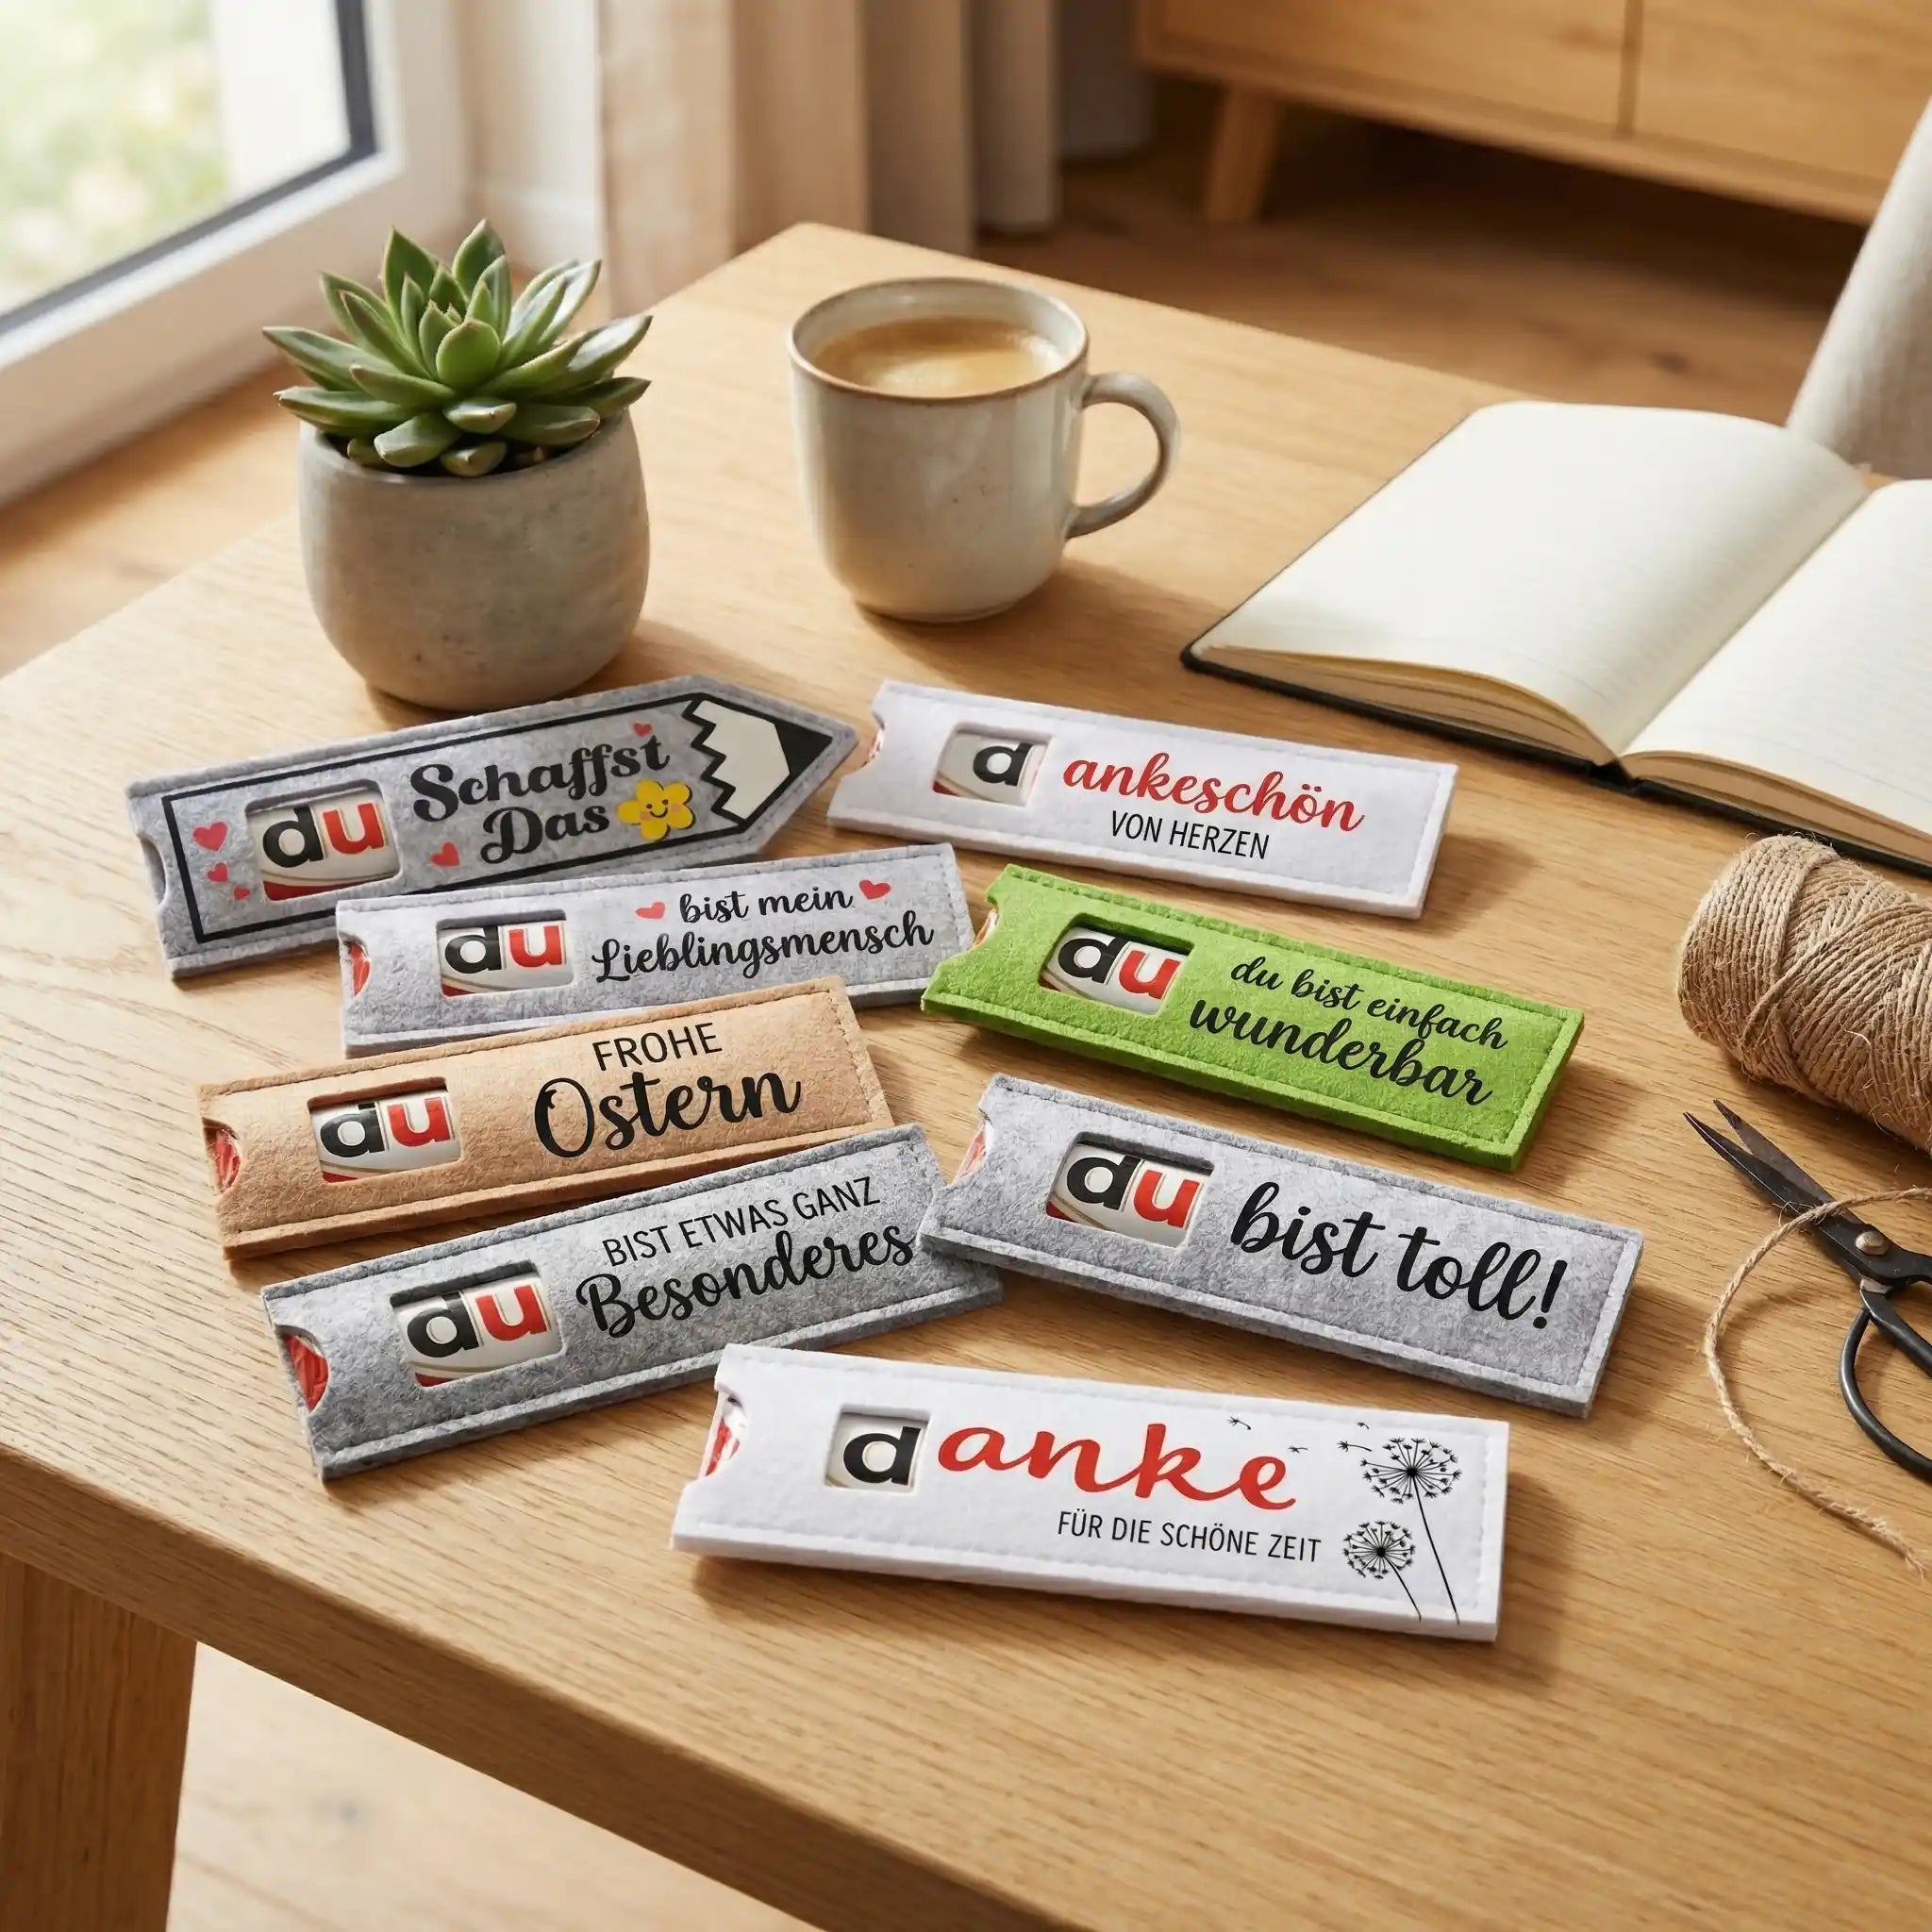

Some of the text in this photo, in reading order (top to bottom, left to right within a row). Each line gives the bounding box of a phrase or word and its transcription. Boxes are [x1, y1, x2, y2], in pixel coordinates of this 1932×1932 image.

[410, 734, 671, 823] Schaffst
[261, 802, 386, 868] du
[480, 805, 609, 865] Das
[1110, 811, 1270, 859] VON HERZEN
[679, 886, 854, 924] bist mein
[444, 924, 564, 974] du
[591, 910, 934, 983] Lieblingsmensch
[1058, 935, 1181, 999] du
[1230, 957, 1508, 1050] du bist einfach
[592, 1023, 723, 1072] FROHE
[1189, 1000, 1493, 1106] wunderbar
[320, 1097, 454, 1158] du
[534, 1073, 801, 1158] Ostern
[602, 1176, 881, 1267] BIST ETWAS GANZ
[1066, 1154, 1201, 1229] du
[575, 1224, 915, 1339] Besonderes
[1230, 1182, 1568, 1330] bist toll!
[406, 1286, 548, 1358] du
[1056, 1508, 1323, 1563] FÜR DIE SCHÖNE ZEIT
